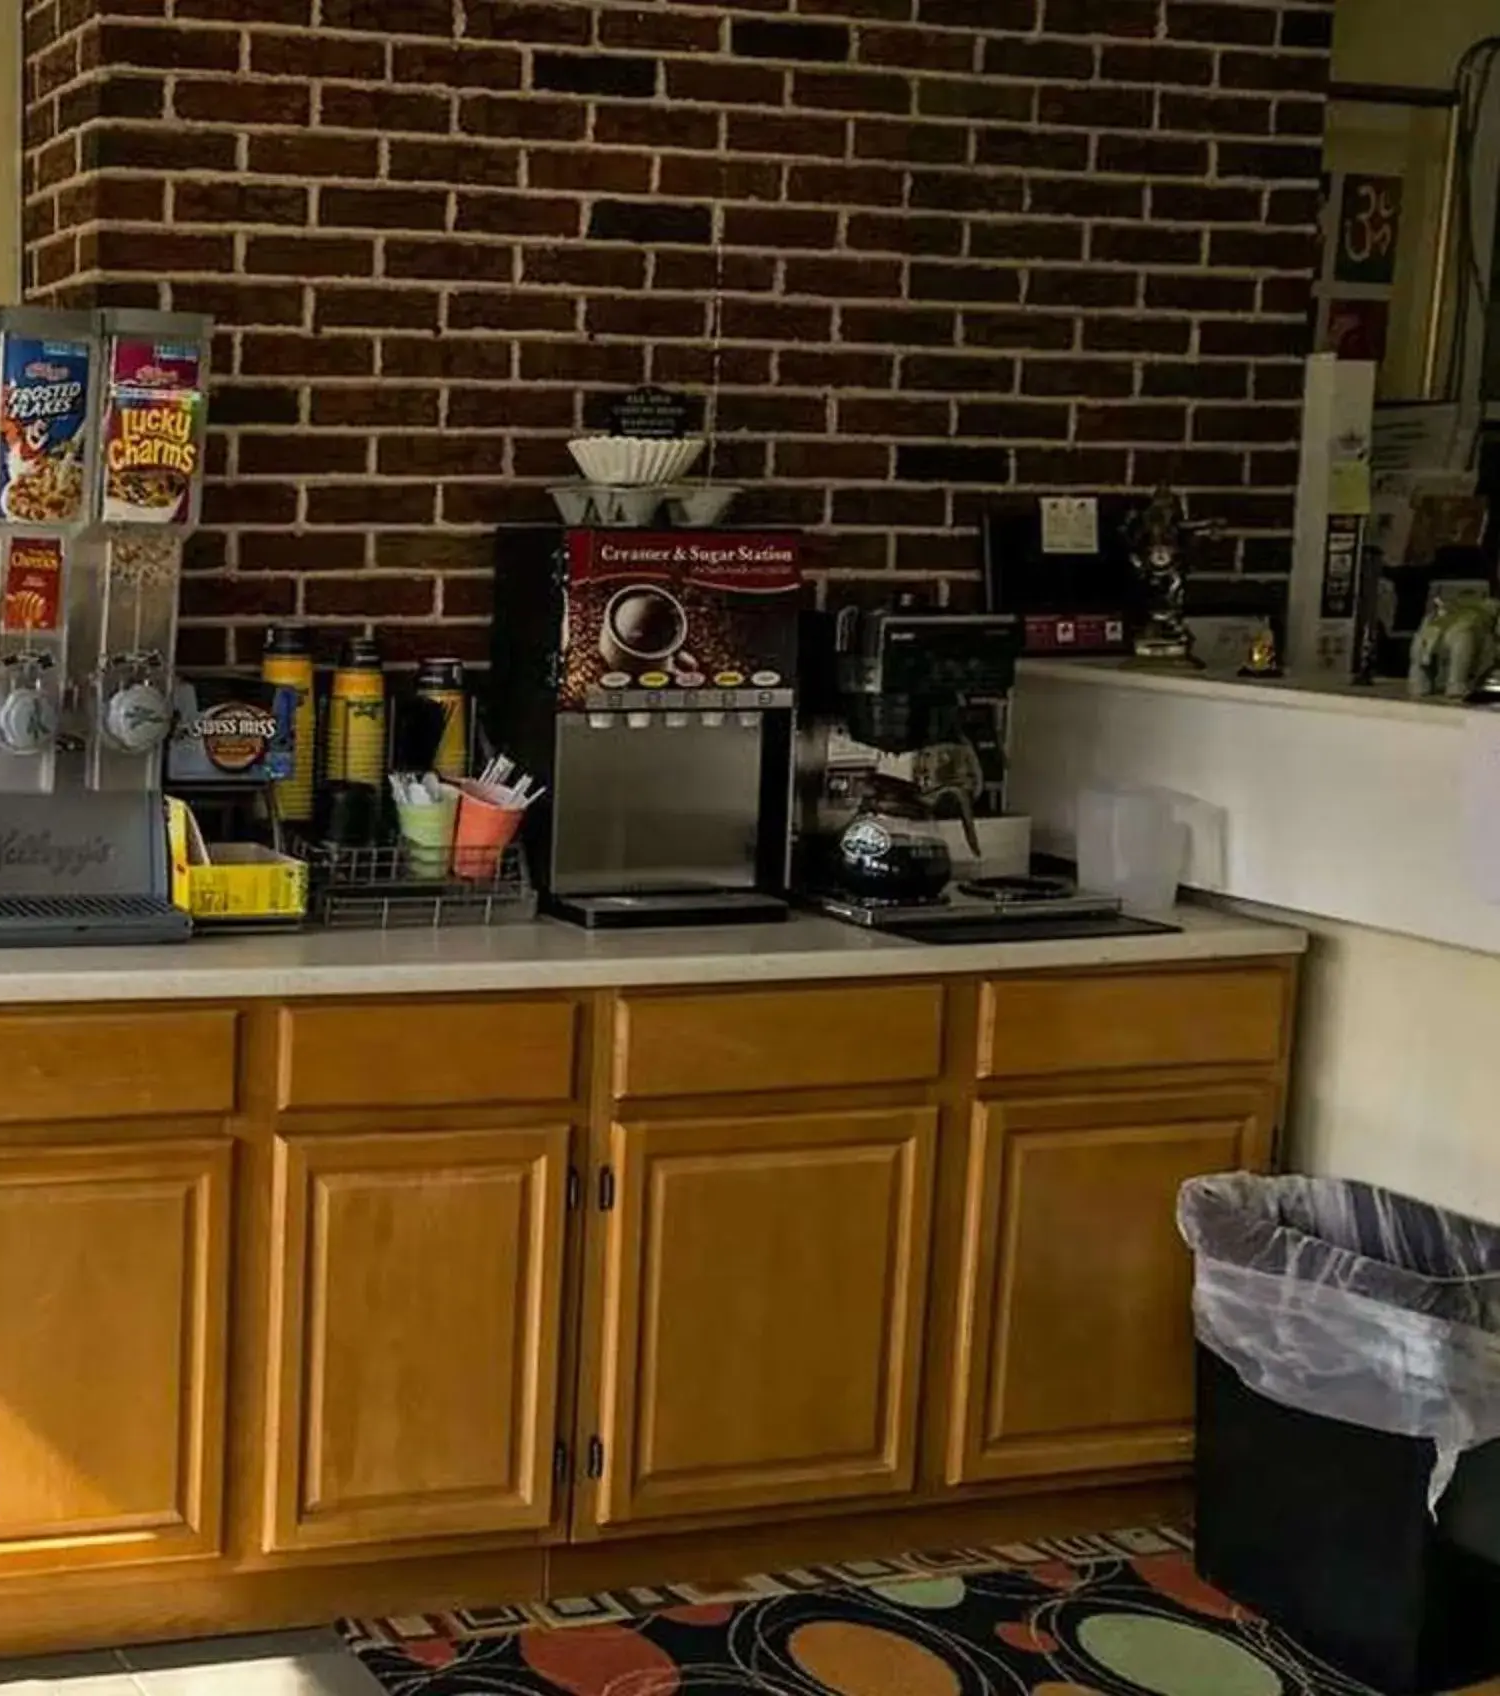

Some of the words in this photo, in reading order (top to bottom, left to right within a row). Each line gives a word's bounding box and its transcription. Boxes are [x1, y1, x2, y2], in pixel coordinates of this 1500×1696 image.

[9, 381, 82, 409] FROSTED
[11, 397, 74, 419] FLAKES
[121, 404, 192, 443] Lucky
[108, 437, 197, 475] Charms
[600, 544, 670, 562] Creamer
[672, 545, 687, 562] &
[688, 544, 736, 565] Sugar
[737, 544, 793, 562] Station
[193, 718, 238, 738] SWISS
[239, 718, 277, 739] MISS
